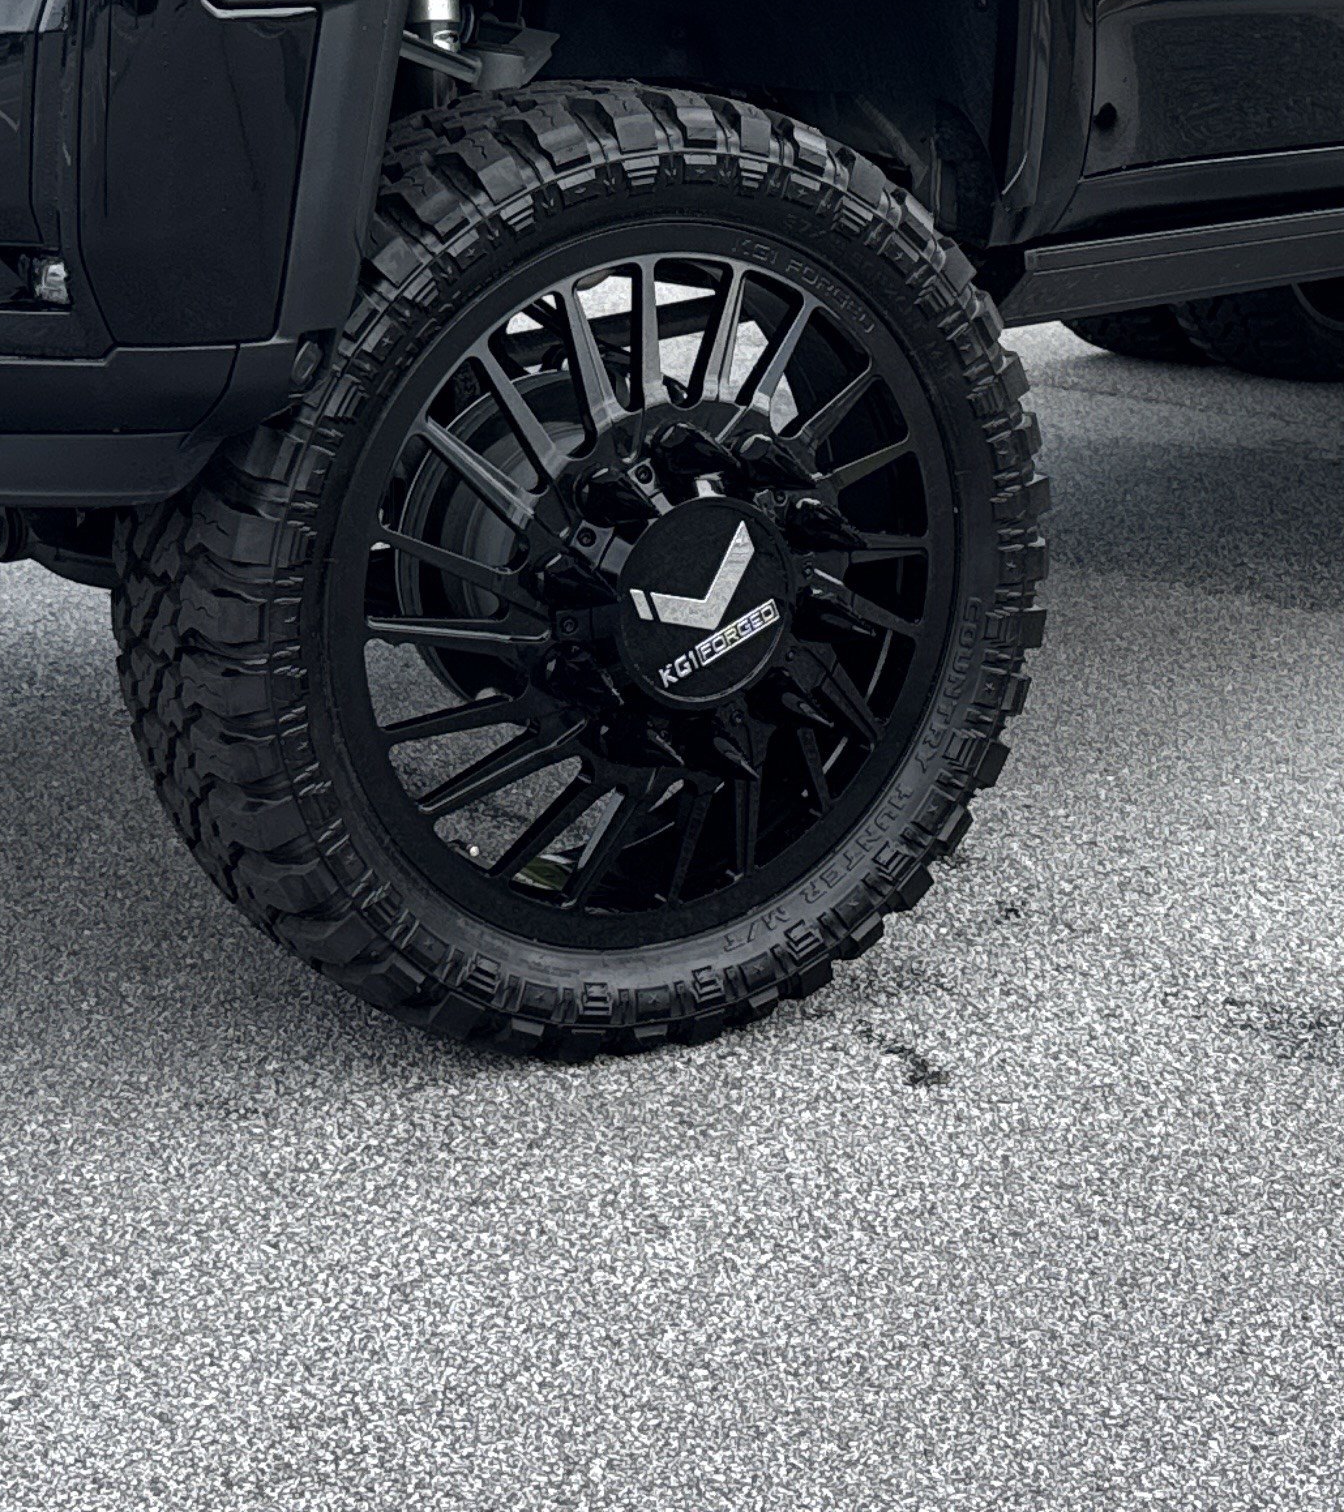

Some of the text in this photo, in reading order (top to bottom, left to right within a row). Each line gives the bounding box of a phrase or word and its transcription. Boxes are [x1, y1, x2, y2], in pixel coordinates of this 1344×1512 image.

[658, 604, 776, 689] KG1 FORGED
[914, 596, 983, 775] COUNTRY
[799, 784, 915, 905] HUNTER
